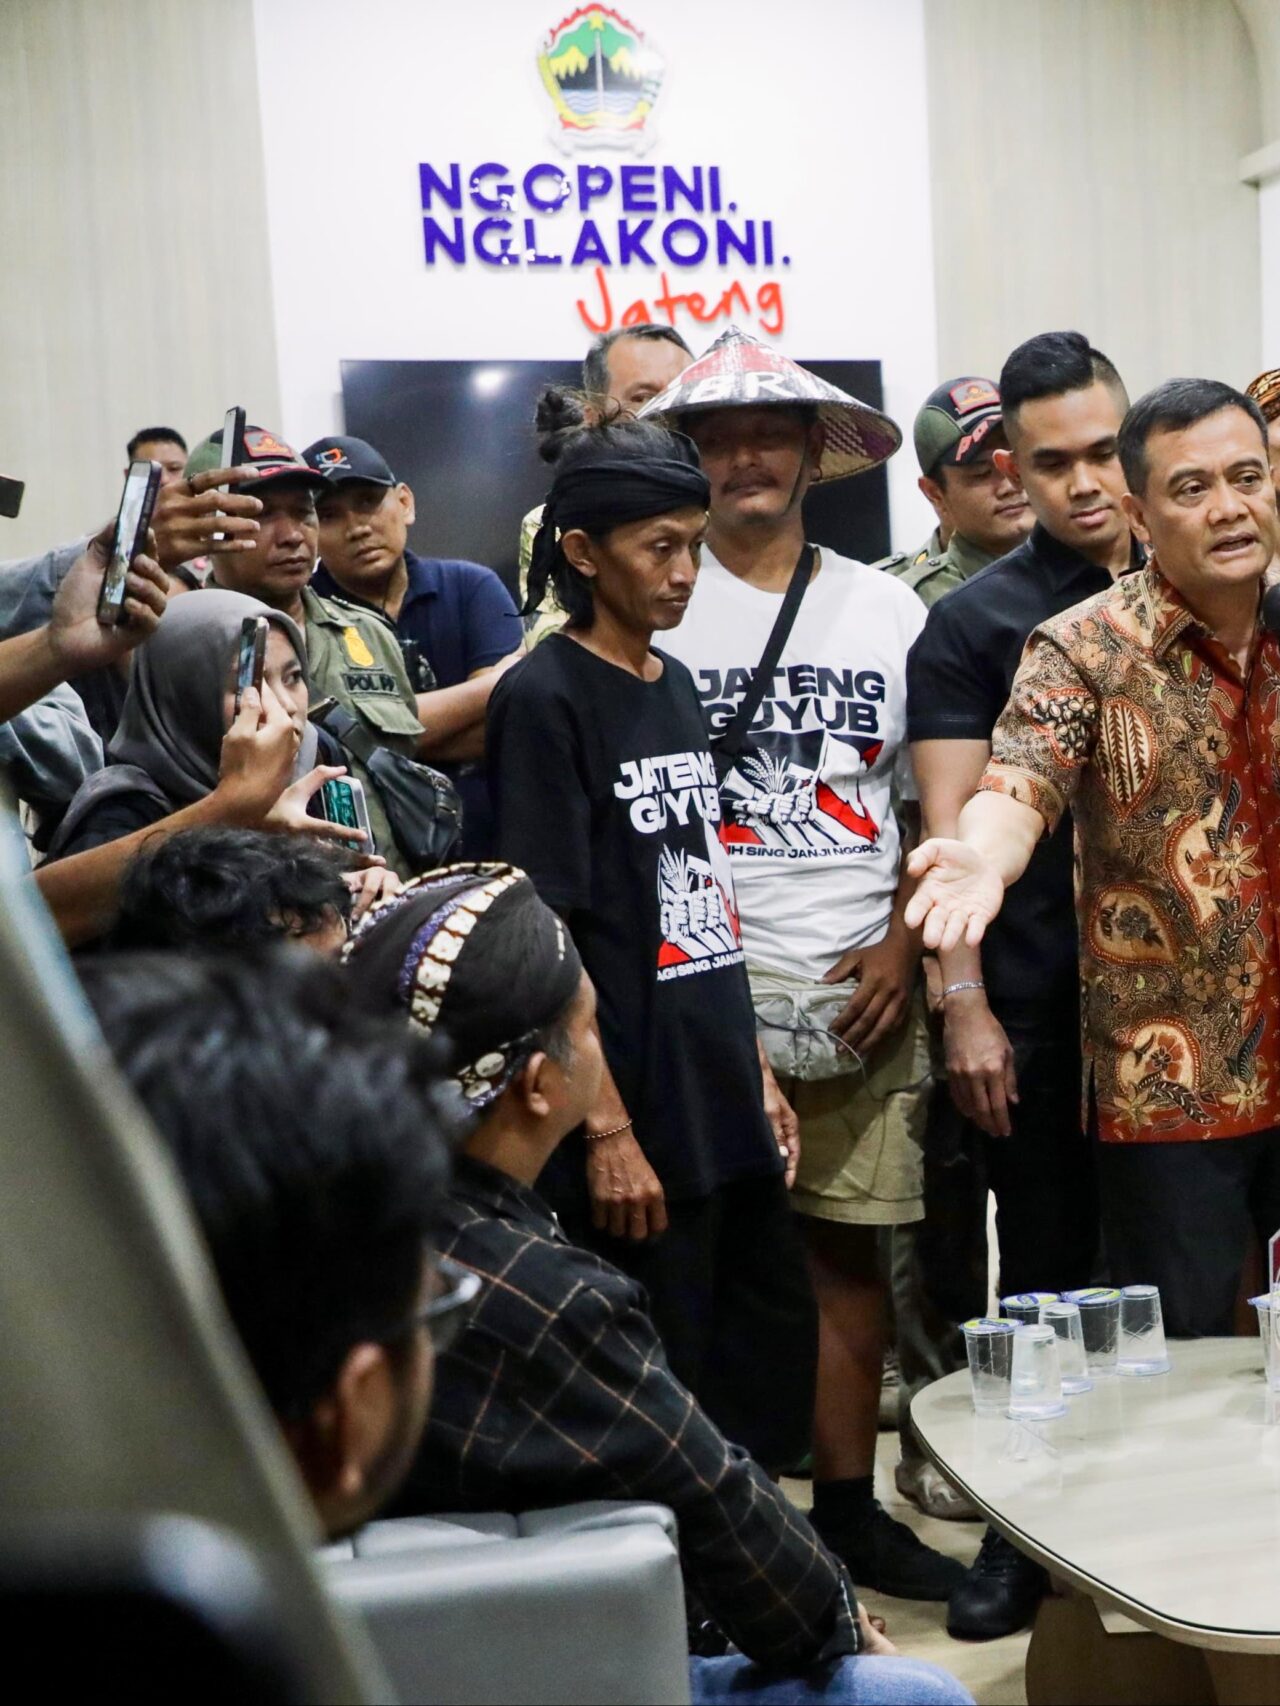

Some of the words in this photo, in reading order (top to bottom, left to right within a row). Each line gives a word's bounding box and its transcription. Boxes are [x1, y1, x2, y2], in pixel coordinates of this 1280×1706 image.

[419, 162, 738, 213] NGOPENI.
[423, 216, 790, 266] NGLAKONI.
[576, 266, 785, 335] Jateng
[698, 664, 886, 703] JATENG
[703, 697, 880, 737] GUYUB
[613, 751, 719, 800] JATENG
[629, 787, 722, 835] GUYUB
[746, 846, 785, 858] SING
[788, 847, 832, 859] JANJI
[677, 959, 712, 977] SING
